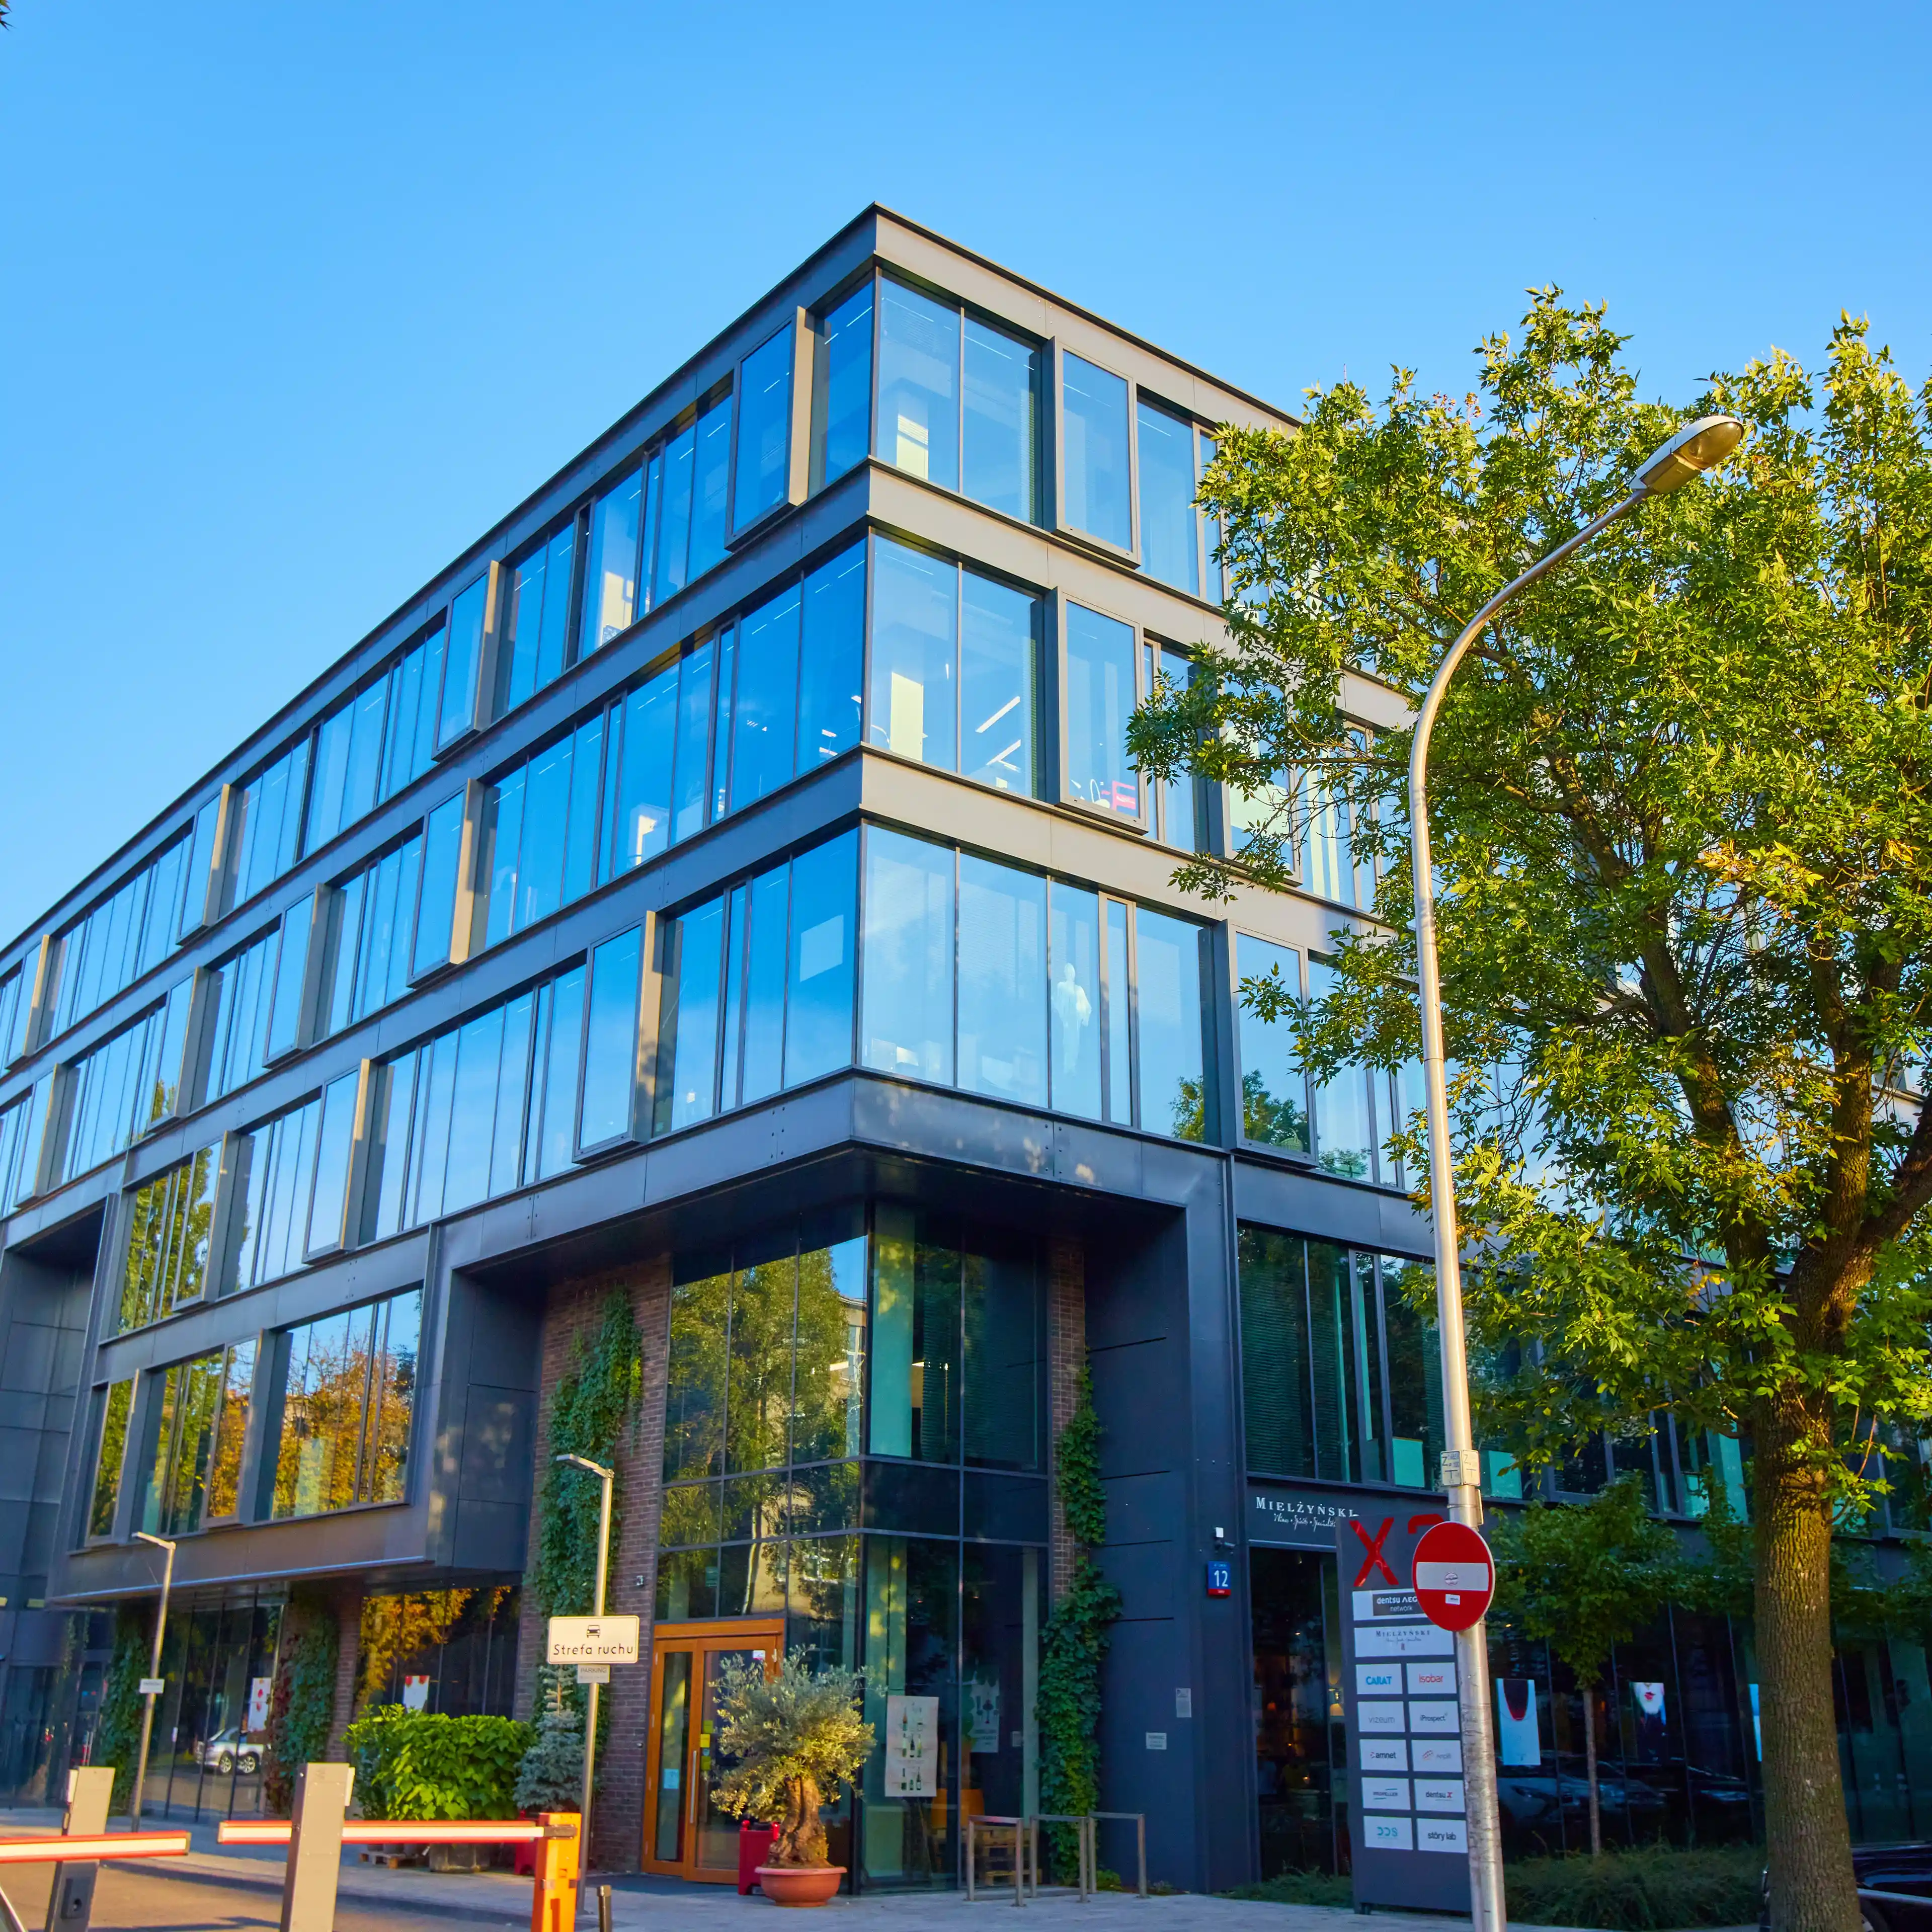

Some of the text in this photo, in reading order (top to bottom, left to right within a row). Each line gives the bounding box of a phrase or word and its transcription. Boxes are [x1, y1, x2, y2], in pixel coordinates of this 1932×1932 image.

[1214, 1570, 1228, 1587] 12
[1377, 1596, 1400, 1604] dentsu
[553, 1643, 633, 1655] Strefa ruchu
[1366, 1676, 1392, 1685] CARAT
[1369, 1716, 1395, 1724] vizeum
